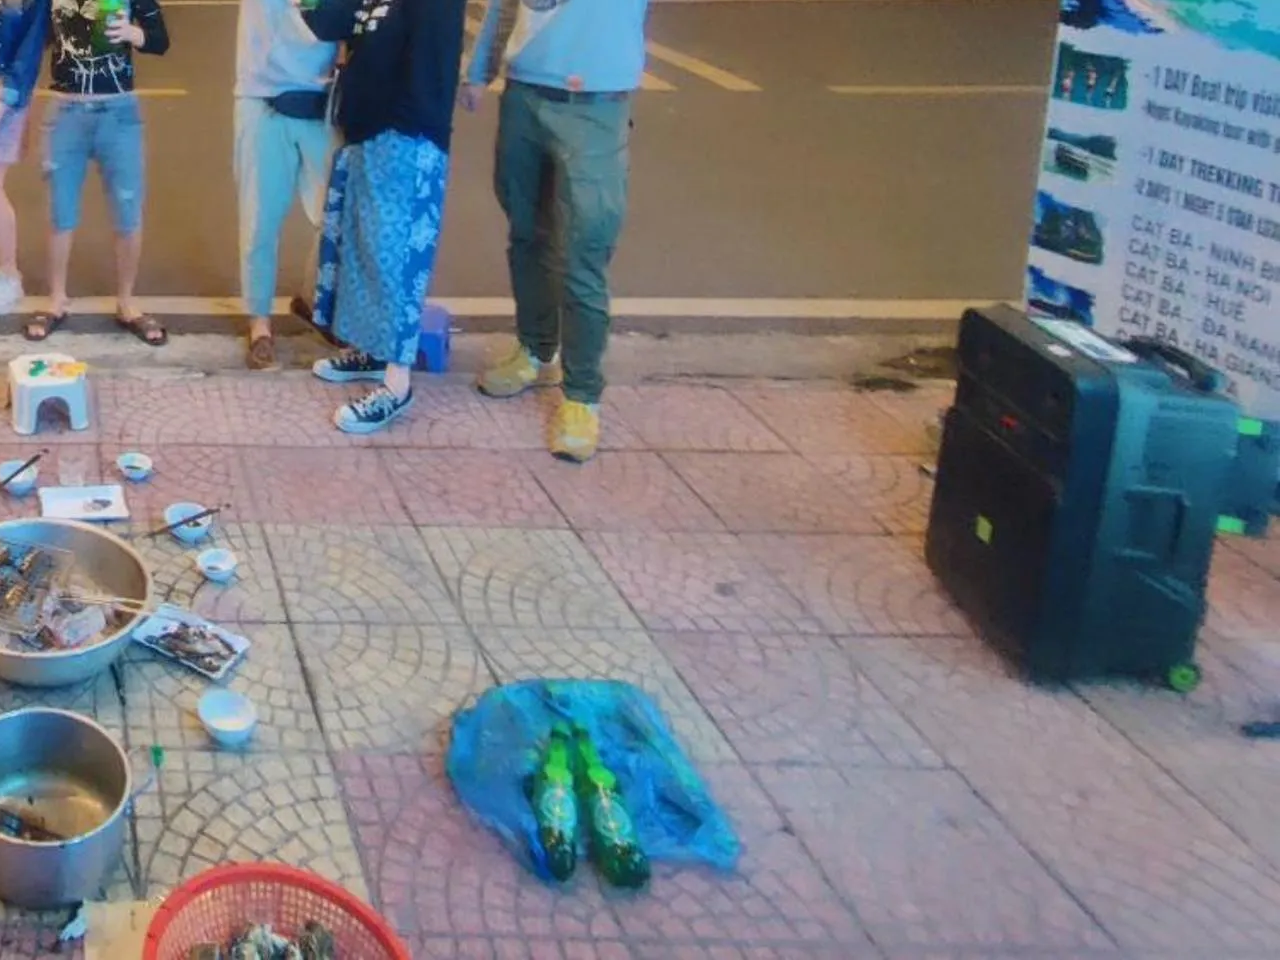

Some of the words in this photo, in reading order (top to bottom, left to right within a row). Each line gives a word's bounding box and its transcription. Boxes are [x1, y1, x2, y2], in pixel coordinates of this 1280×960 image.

[1164, 67, 1190, 93] DAY
[1159, 149, 1184, 173] DAY
[1190, 158, 1263, 198] TREKKING
[1128, 238, 1161, 262] CAT
[1165, 252, 1190, 275] BA
[1205, 265, 1231, 291] HA
[1131, 214, 1164, 237] CAT
[1169, 228, 1193, 250] BA
[1210, 241, 1256, 271] NINH
[1121, 283, 1154, 308] CAT
[1158, 297, 1182, 318] BA
[1125, 261, 1158, 285] CAT
[1161, 276, 1186, 297] BA
[1119, 306, 1151, 331] CAT
[1155, 321, 1179, 346] BA
[1194, 339, 1218, 362] HA
